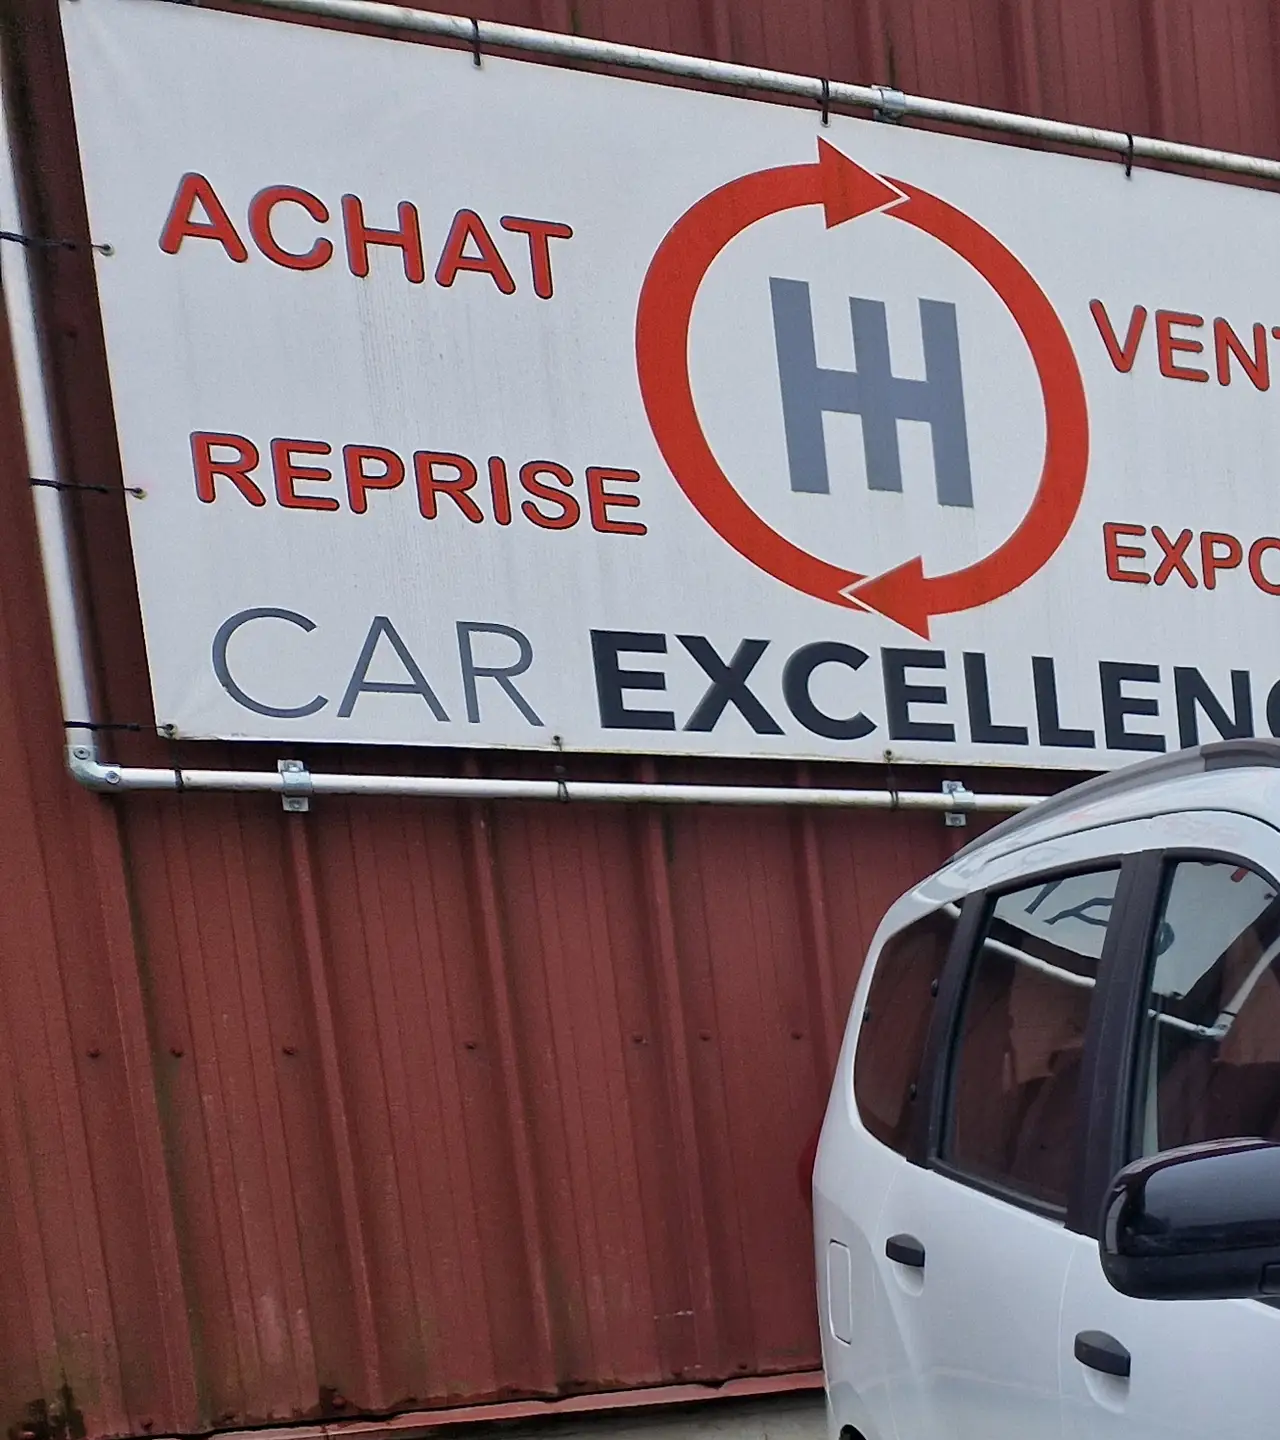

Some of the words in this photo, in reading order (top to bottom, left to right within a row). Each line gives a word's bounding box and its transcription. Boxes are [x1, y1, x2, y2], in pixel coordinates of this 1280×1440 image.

[159, 172, 574, 300] ACHAT
[190, 431, 648, 536] REPRISE
[212, 608, 545, 727] CAR
